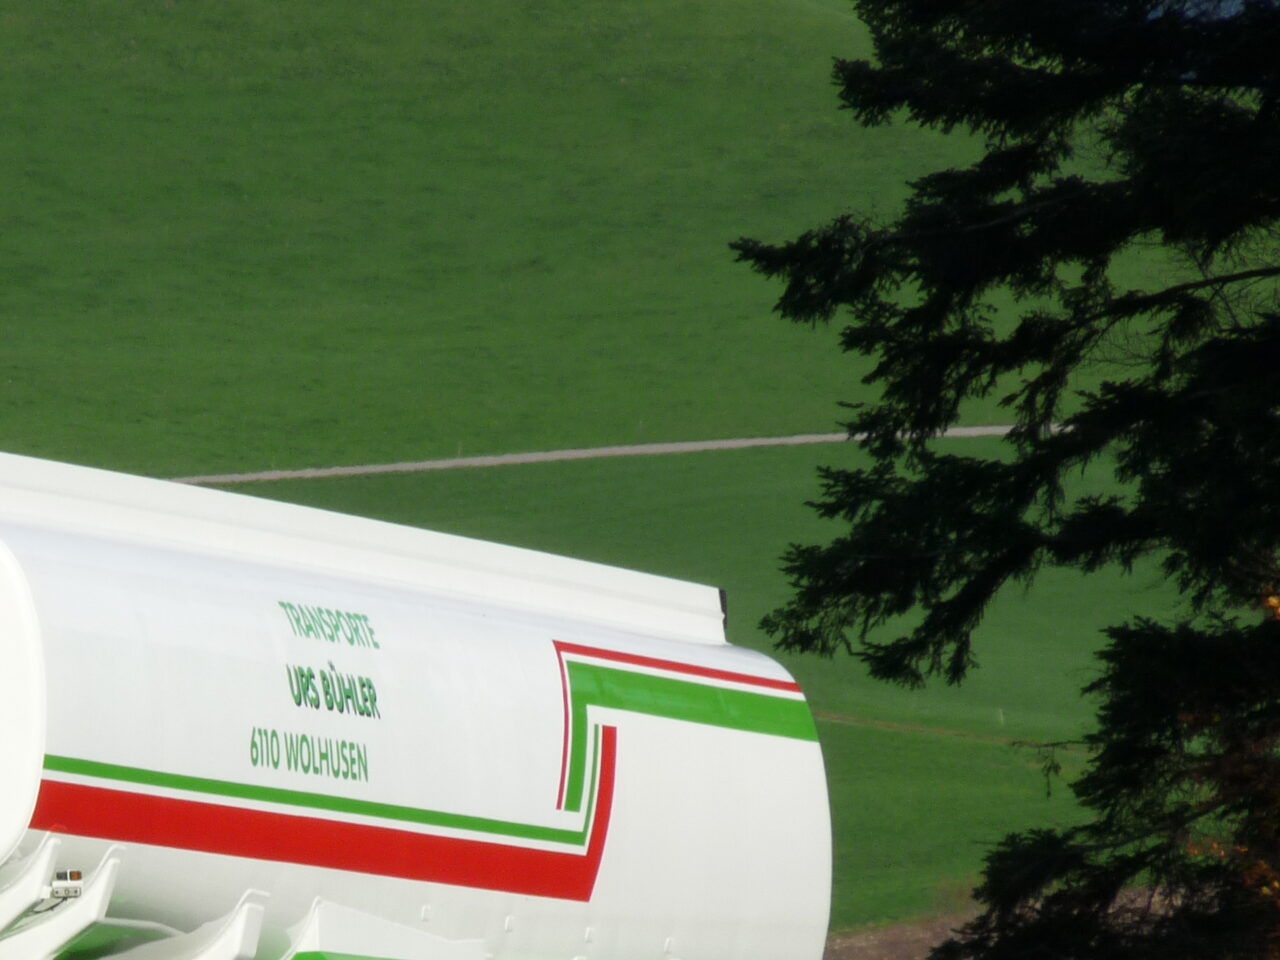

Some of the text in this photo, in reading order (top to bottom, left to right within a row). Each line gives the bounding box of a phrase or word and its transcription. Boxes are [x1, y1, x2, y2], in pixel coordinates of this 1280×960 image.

[278, 601, 381, 649] TRANSPORTE
[286, 659, 382, 719] URS BÜHLER
[250, 726, 369, 783] 6110 WOLHUSEN
